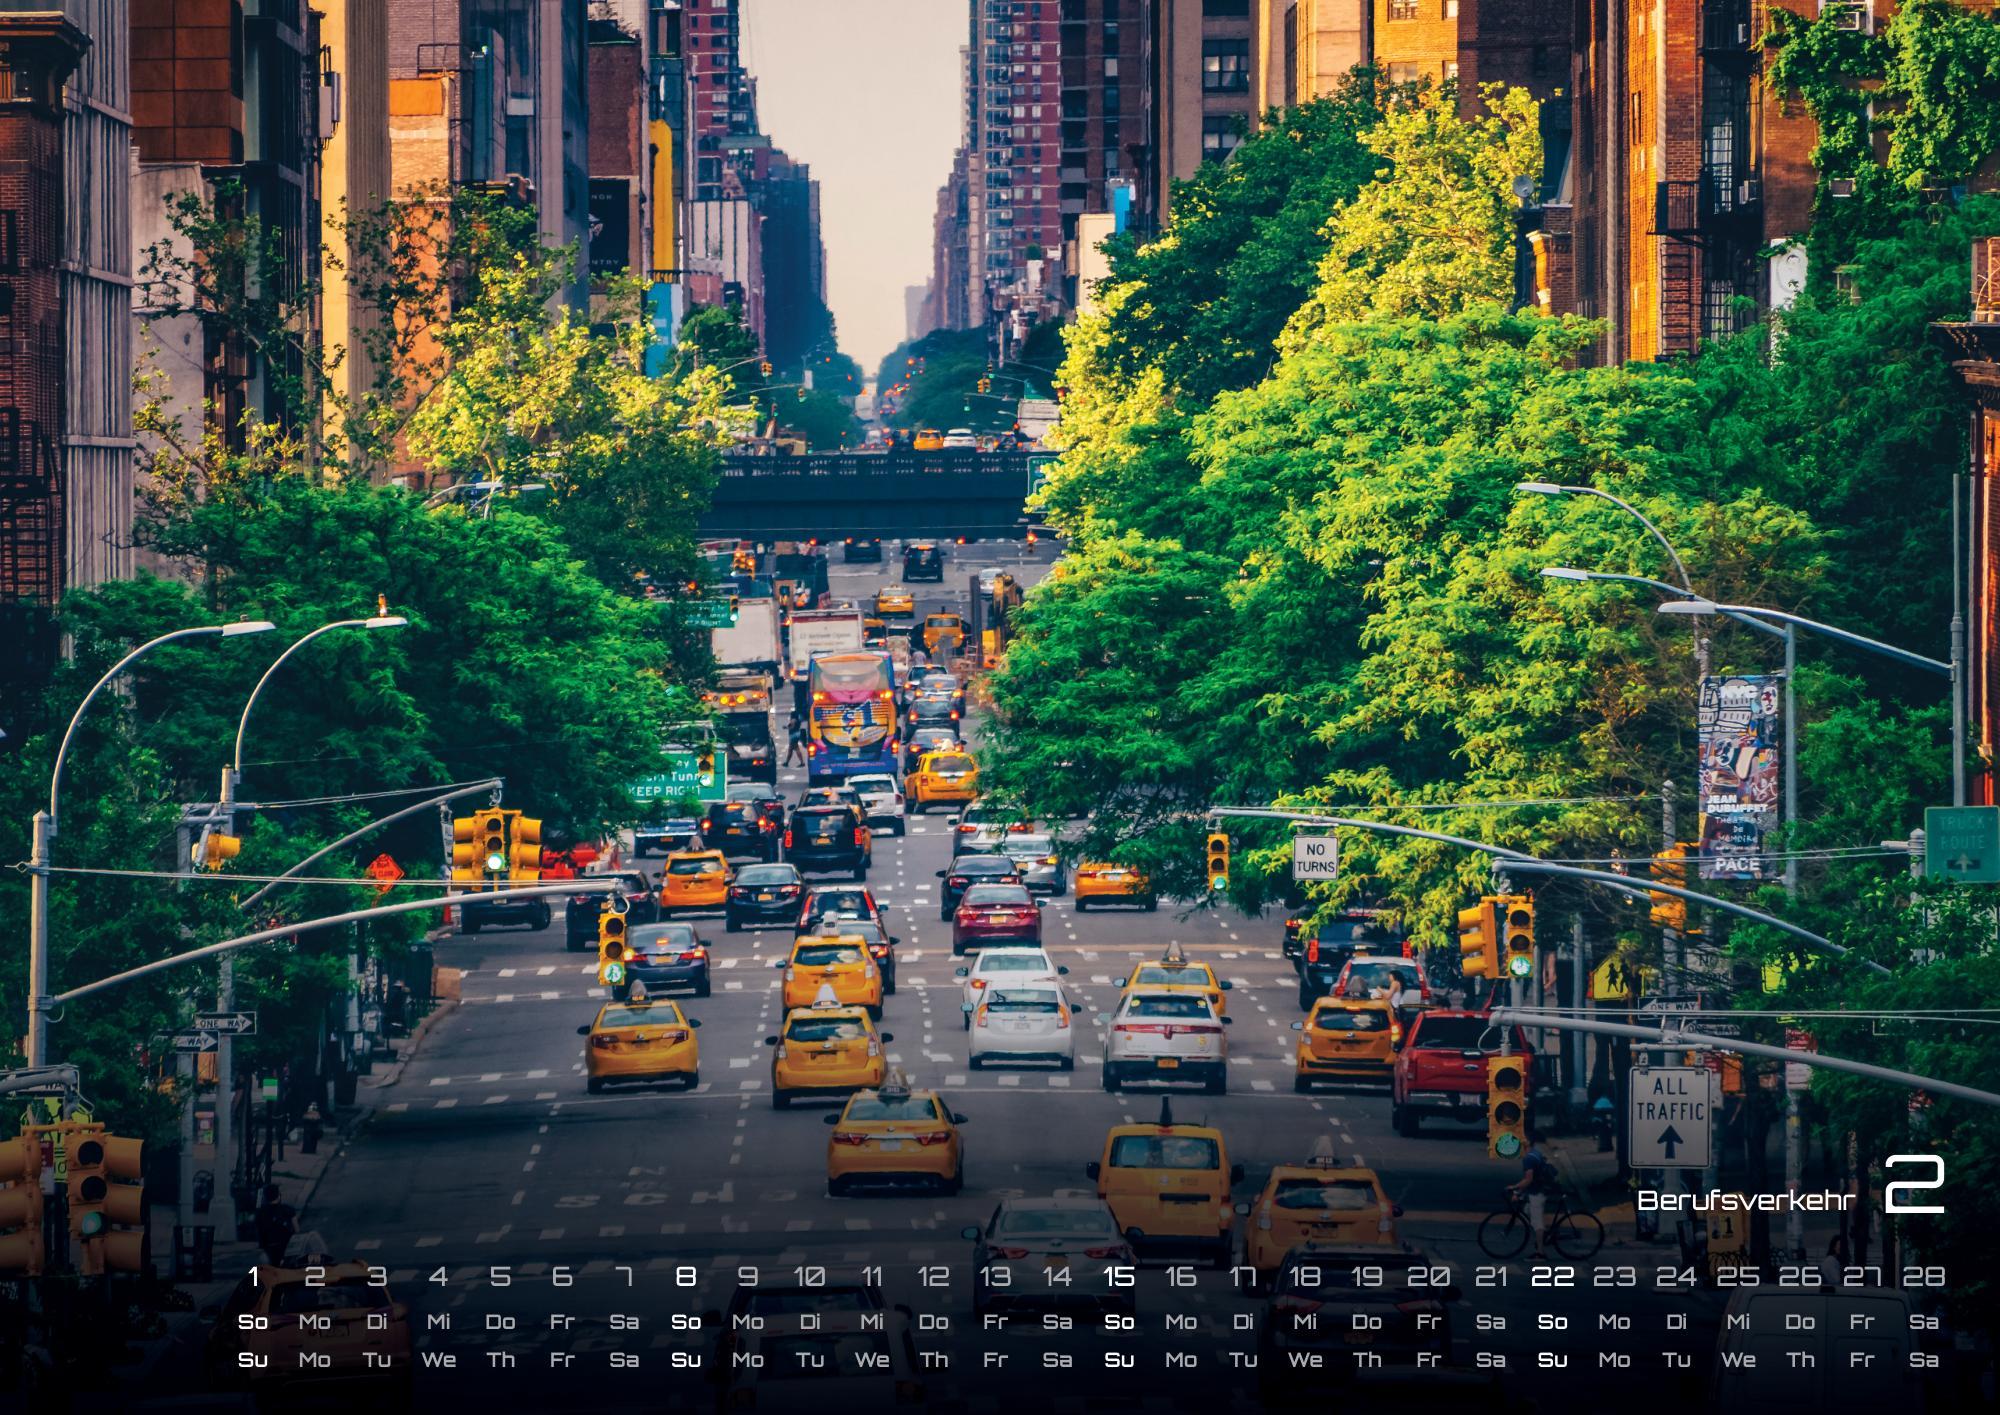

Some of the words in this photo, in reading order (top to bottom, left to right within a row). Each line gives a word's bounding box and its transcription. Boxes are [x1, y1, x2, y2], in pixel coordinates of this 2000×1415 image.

[1719, 685, 1758, 699] NYC
[1707, 794, 1737, 804] JEAN
[1707, 803, 1768, 814] DUBUFFET
[1939, 815, 1985, 830] TRUCK
[1941, 834, 1985, 850] ROUTE
[1306, 843, 1325, 856] NO
[1296, 861, 1335, 873] TURNS
[1715, 857, 1761, 871] PACE
[1651, 1003, 1670, 1011] ONE
[1676, 1002, 1697, 1011] WAY
[199, 1018, 221, 1029] ONE
[227, 1018, 247, 1028] WAY
[186, 1036, 209, 1047] WAY
[1653, 1077, 1689, 1096] ALL
[1637, 1102, 1705, 1121] TRAFFIC
